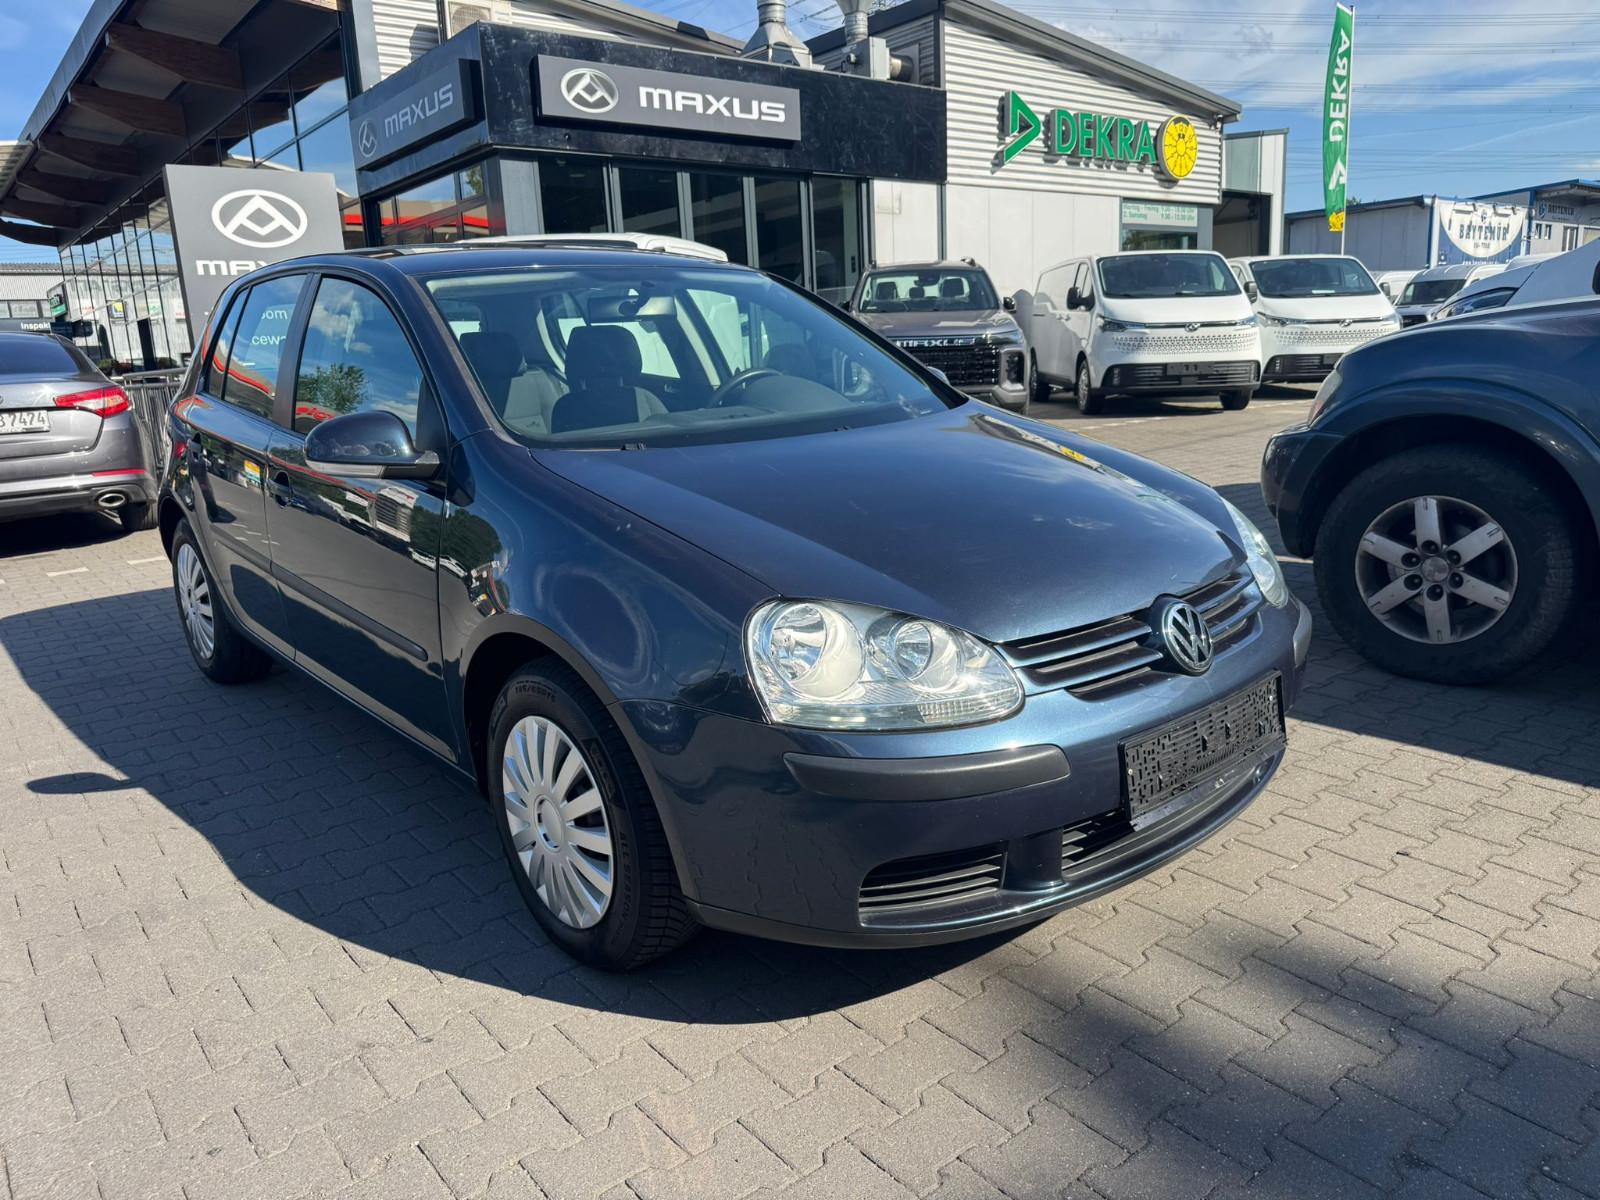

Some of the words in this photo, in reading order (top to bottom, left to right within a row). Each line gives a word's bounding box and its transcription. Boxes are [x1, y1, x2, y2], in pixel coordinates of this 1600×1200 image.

[383, 82, 454, 139] MAXUS
[639, 86, 786, 123] MAXUS
[1054, 107, 1158, 165] DEKRA
